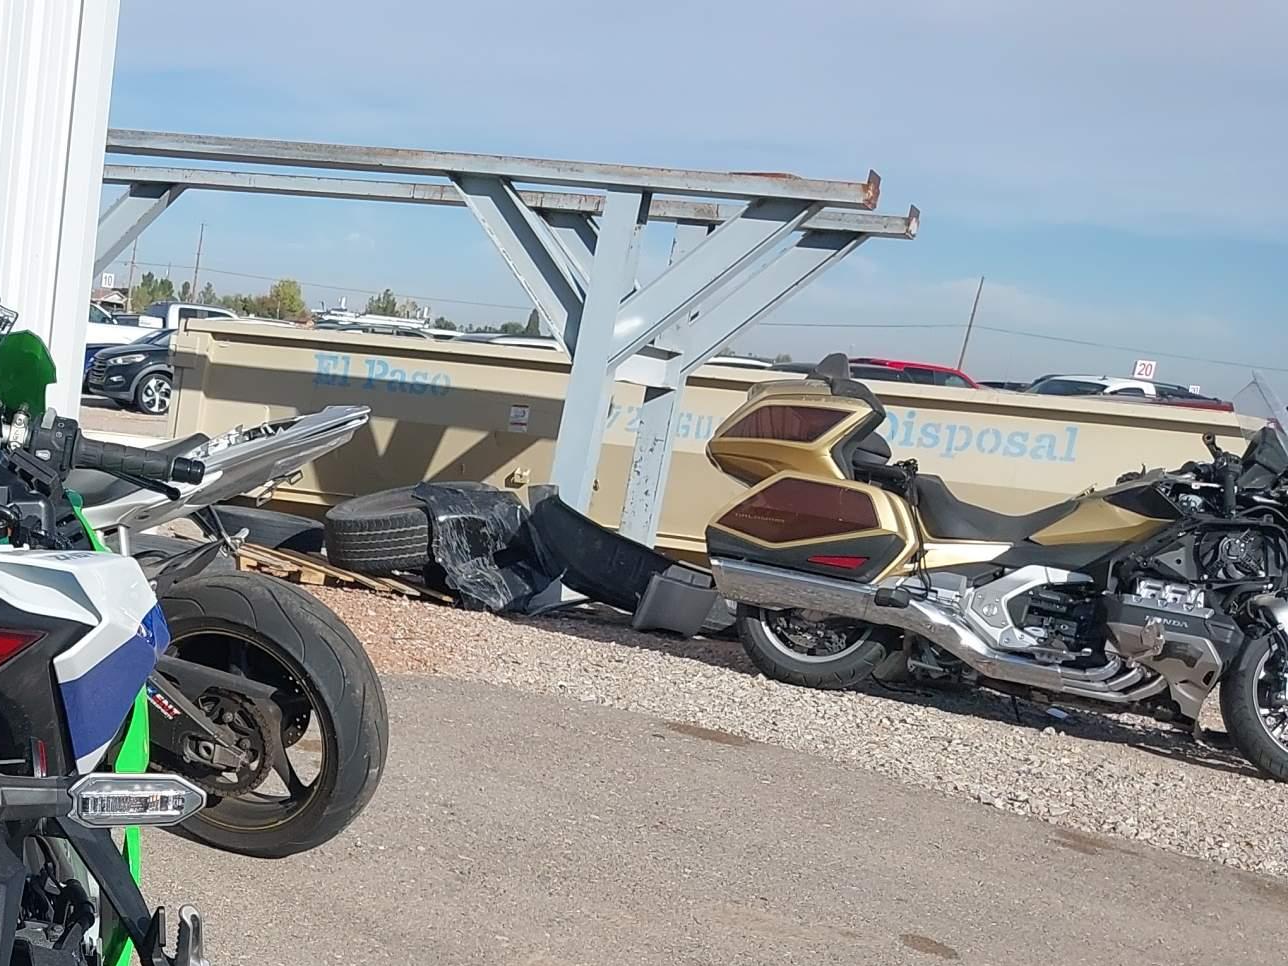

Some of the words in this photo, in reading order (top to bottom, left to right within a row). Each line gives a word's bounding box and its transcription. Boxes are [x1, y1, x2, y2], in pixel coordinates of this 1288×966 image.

[314, 352, 351, 387] El
[363, 356, 452, 396] Paso
[1137, 362, 1153, 377] 20
